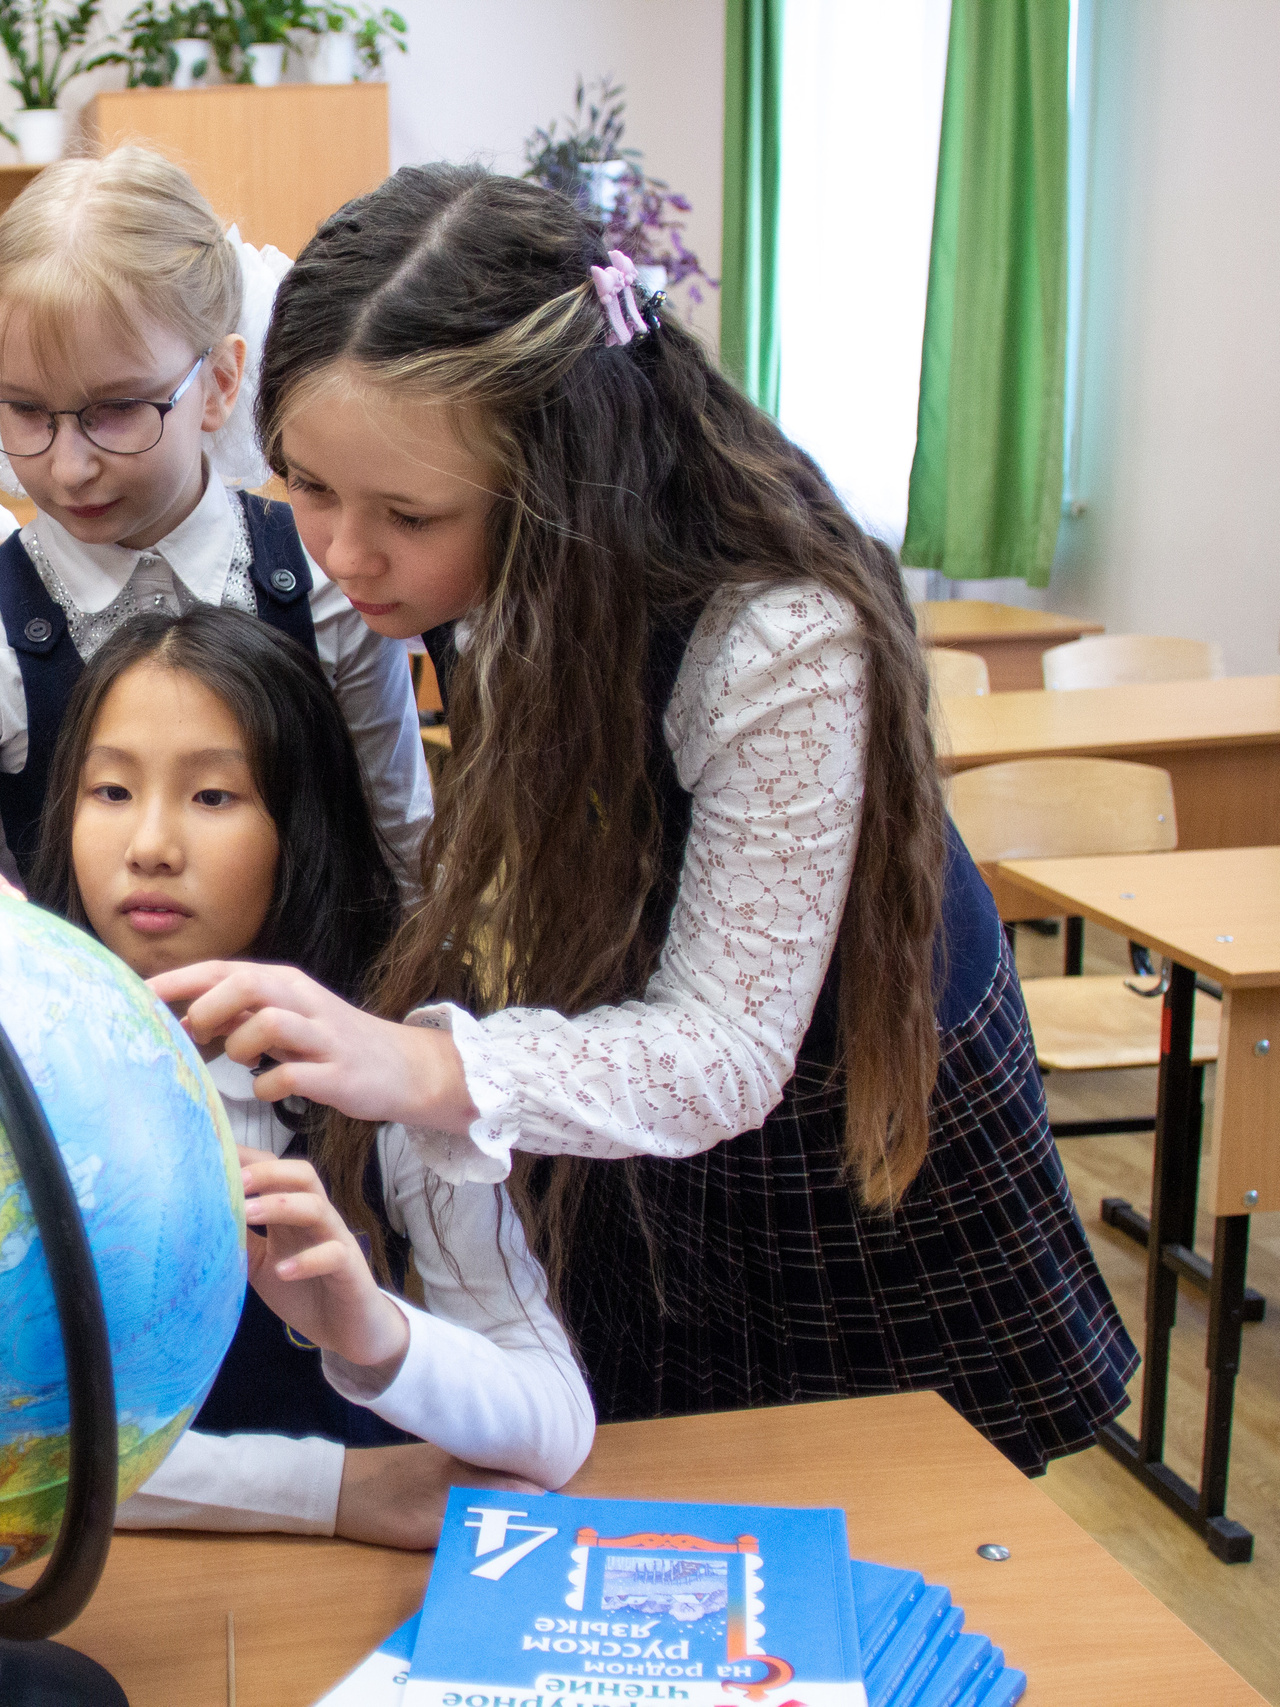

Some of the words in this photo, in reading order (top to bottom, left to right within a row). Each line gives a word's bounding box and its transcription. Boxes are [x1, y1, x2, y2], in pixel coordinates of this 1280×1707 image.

[465, 1508, 559, 1581] 4
[535, 1618, 660, 1638] языке
[523, 1636, 690, 1661] русском
[584, 1660, 703, 1679] родном
[718, 1666, 752, 1679] на
[545, 1678, 689, 1700] чтение
